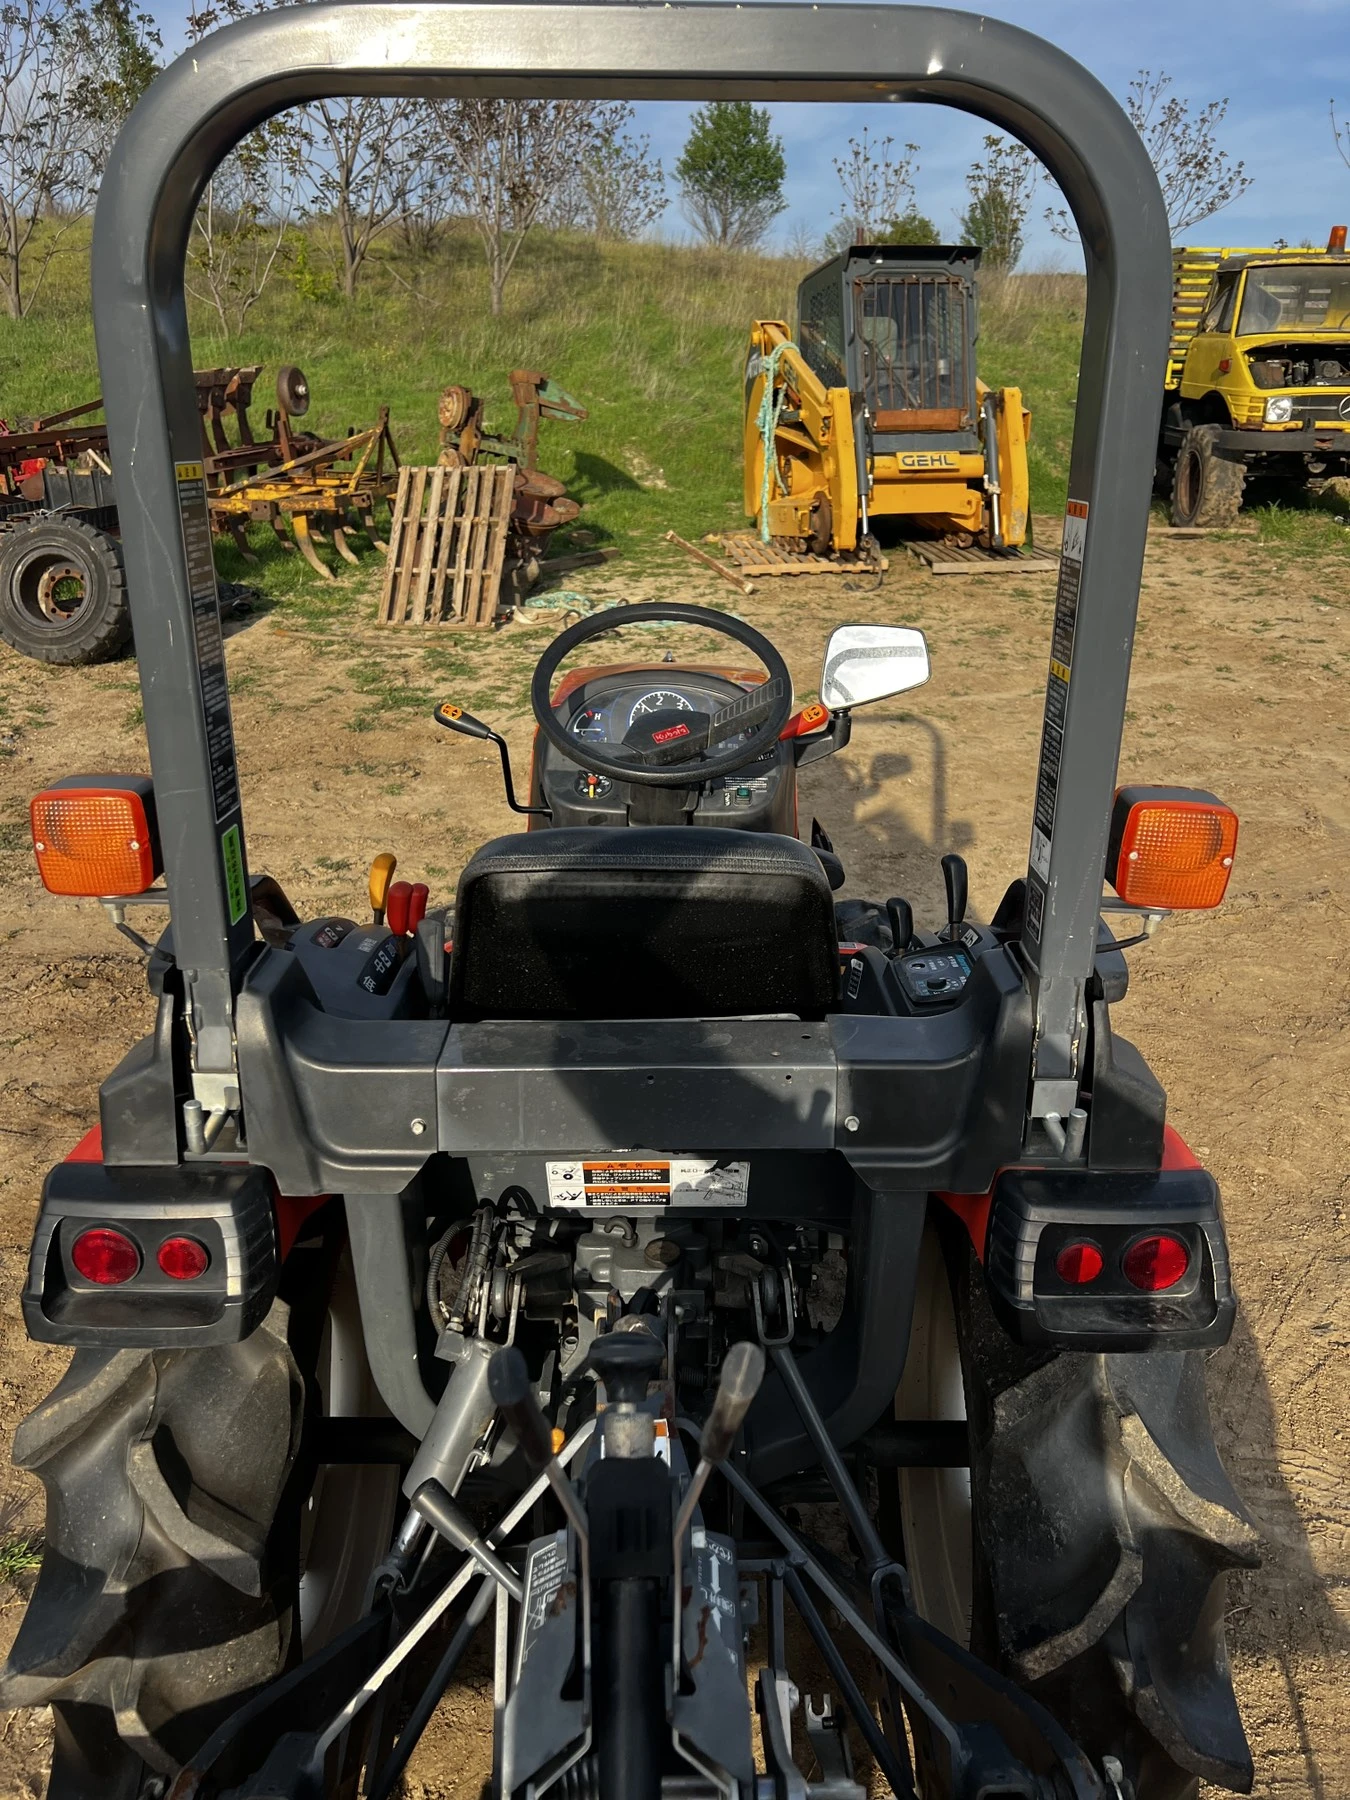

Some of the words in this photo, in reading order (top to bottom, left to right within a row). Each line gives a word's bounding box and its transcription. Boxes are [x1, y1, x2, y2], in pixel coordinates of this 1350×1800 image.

[902, 455, 956, 466] GEHL
[656, 697, 664, 706] 2
[594, 713, 602, 721] H
[654, 727, 687, 741] Kubota
[738, 733, 745, 741] E
[374, 959, 385, 974] 中
[363, 975, 376, 993] 低
